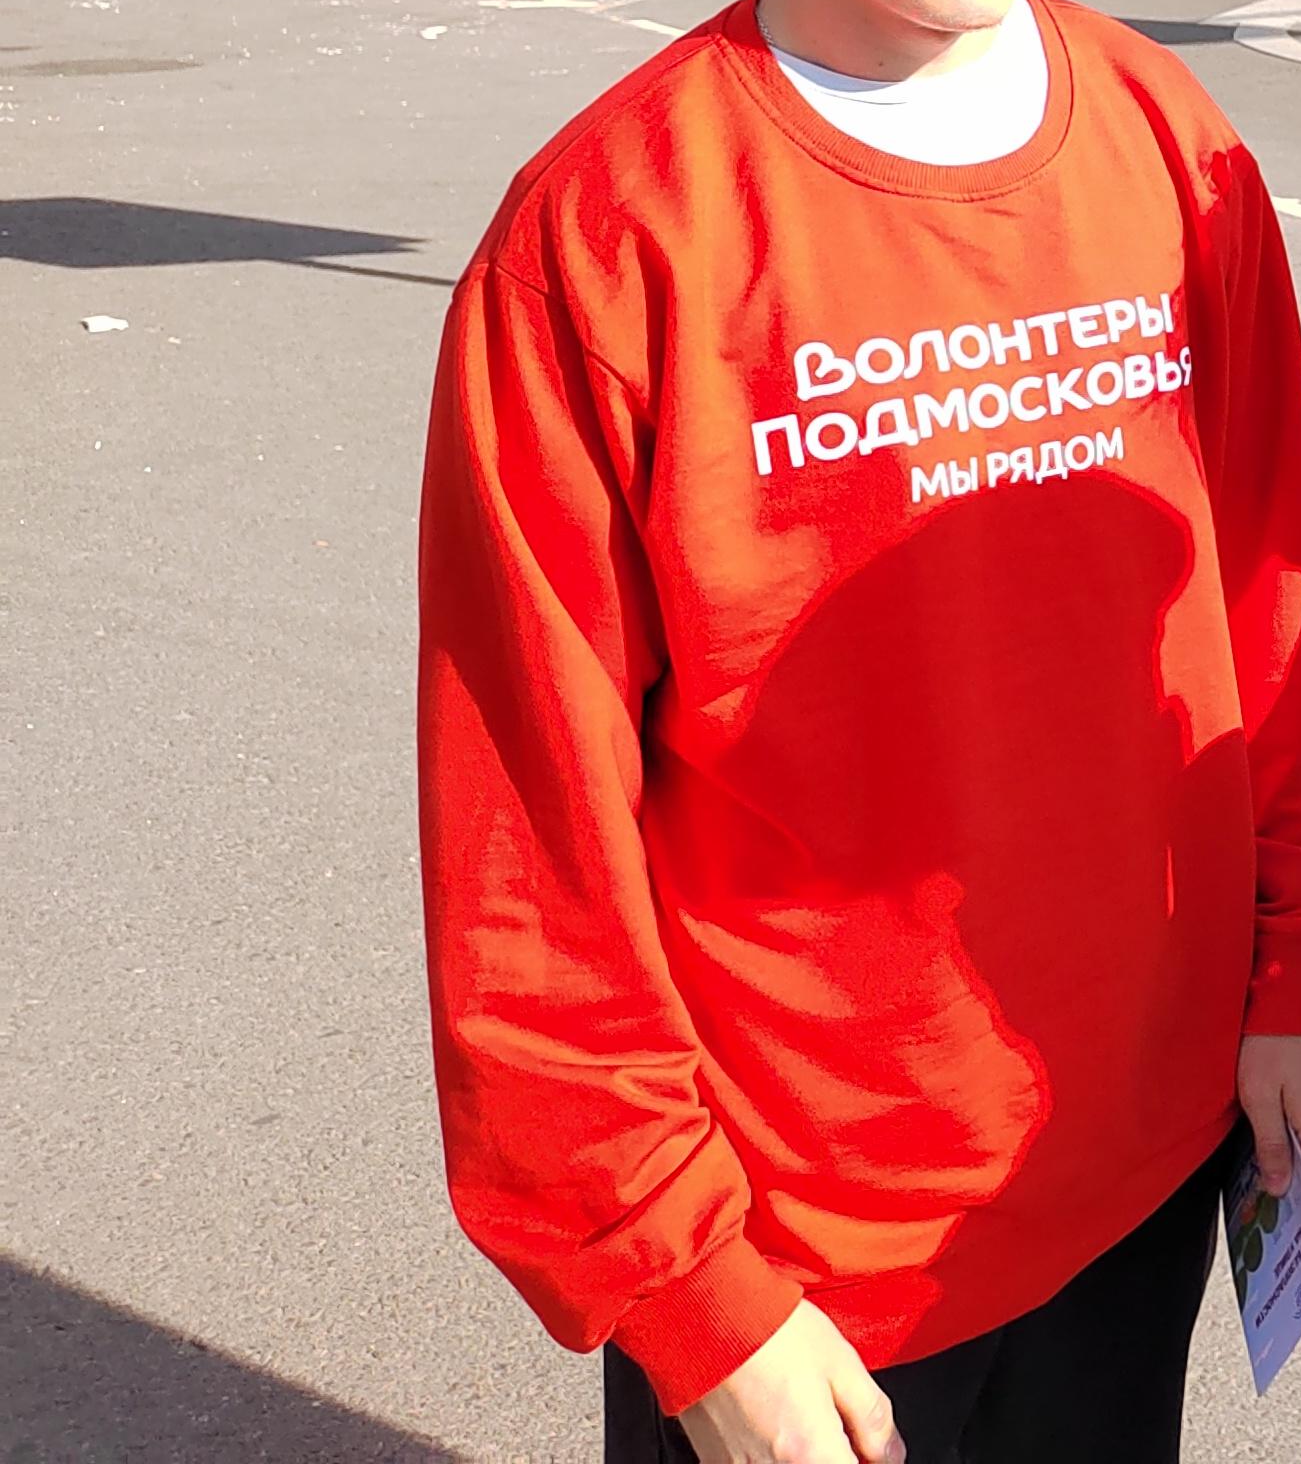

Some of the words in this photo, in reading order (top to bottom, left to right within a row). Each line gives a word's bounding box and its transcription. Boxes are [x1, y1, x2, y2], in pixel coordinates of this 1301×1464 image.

[793, 293, 1174, 402] ВОЛОНТЕРЫ
[751, 346, 1192, 476] ПОДМОСКОВЬЯ
[910, 455, 979, 503] МЫ
[986, 426, 1124, 485] РЯДОМ
